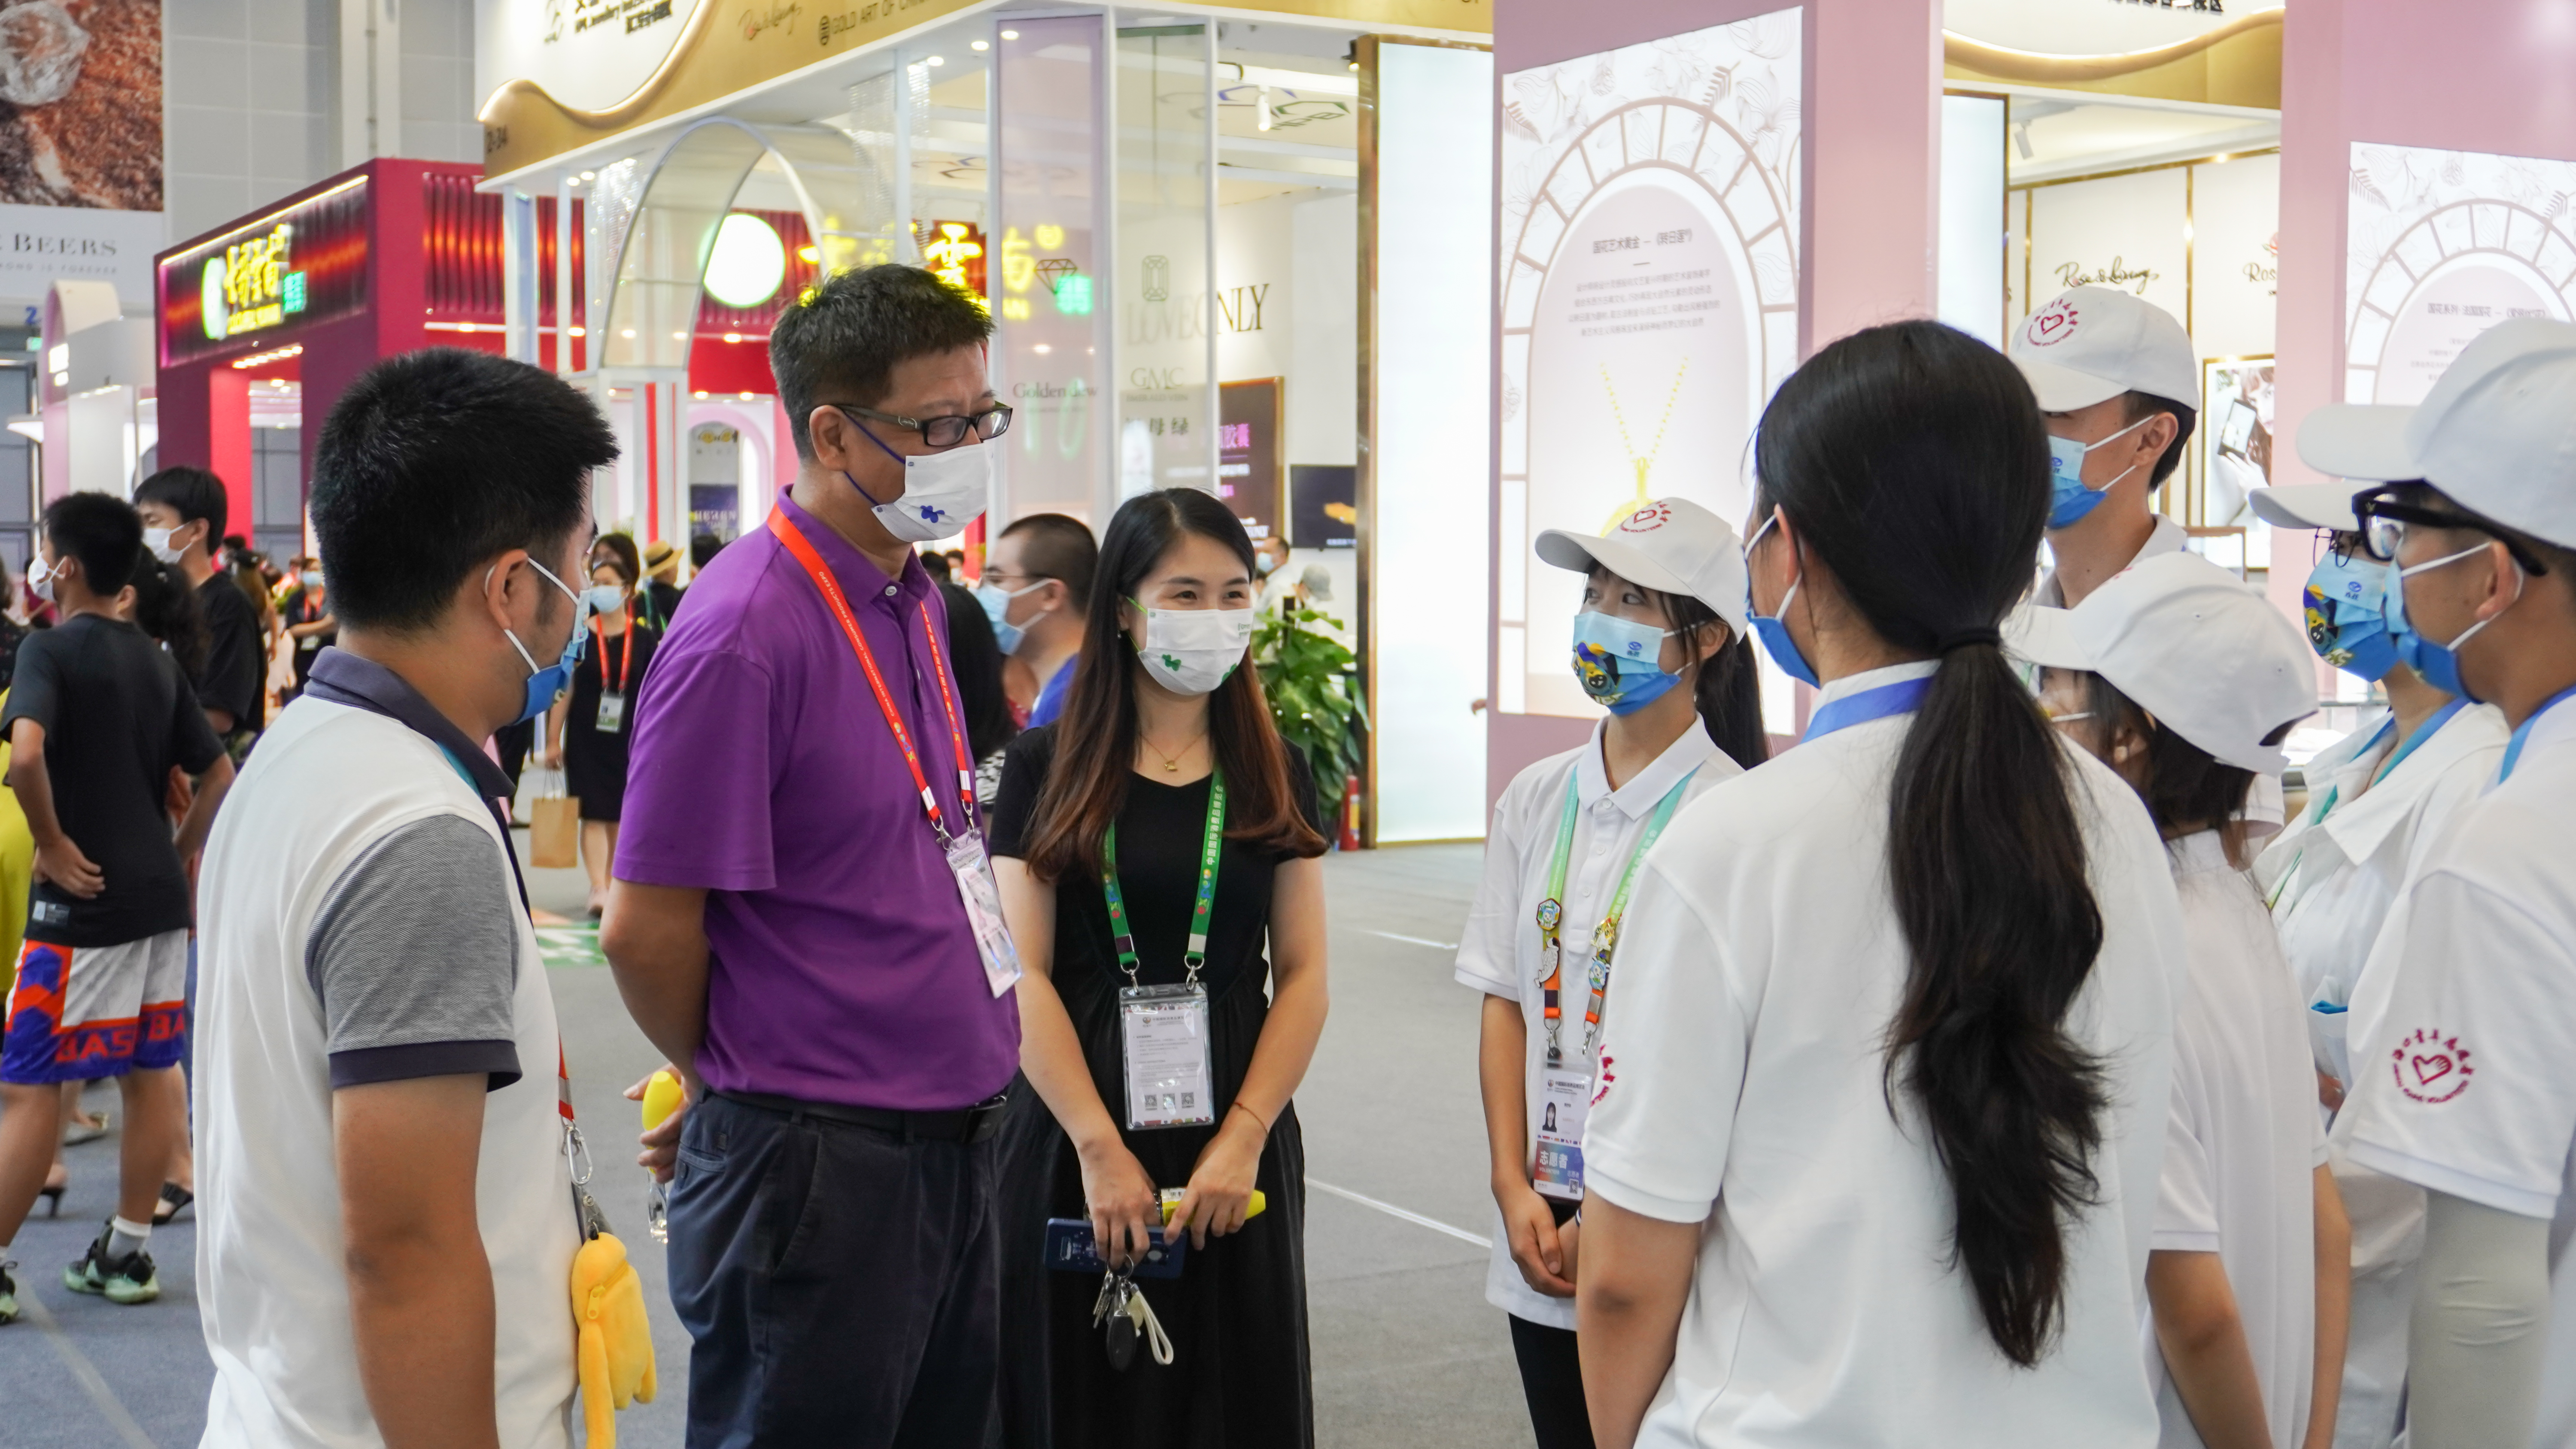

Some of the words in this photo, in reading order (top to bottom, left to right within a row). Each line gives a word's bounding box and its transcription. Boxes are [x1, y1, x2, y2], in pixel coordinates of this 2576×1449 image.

[15, 233, 116, 255] BEERS
[1130, 367, 1184, 390] GMC
[1013, 382, 1067, 398] Golden
[818, 570, 832, 588] EXPO
[828, 587, 848, 618] PRODUCTS
[844, 618, 866, 651] CONSUMER
[1540, 1150, 1568, 1170] 志愿者
